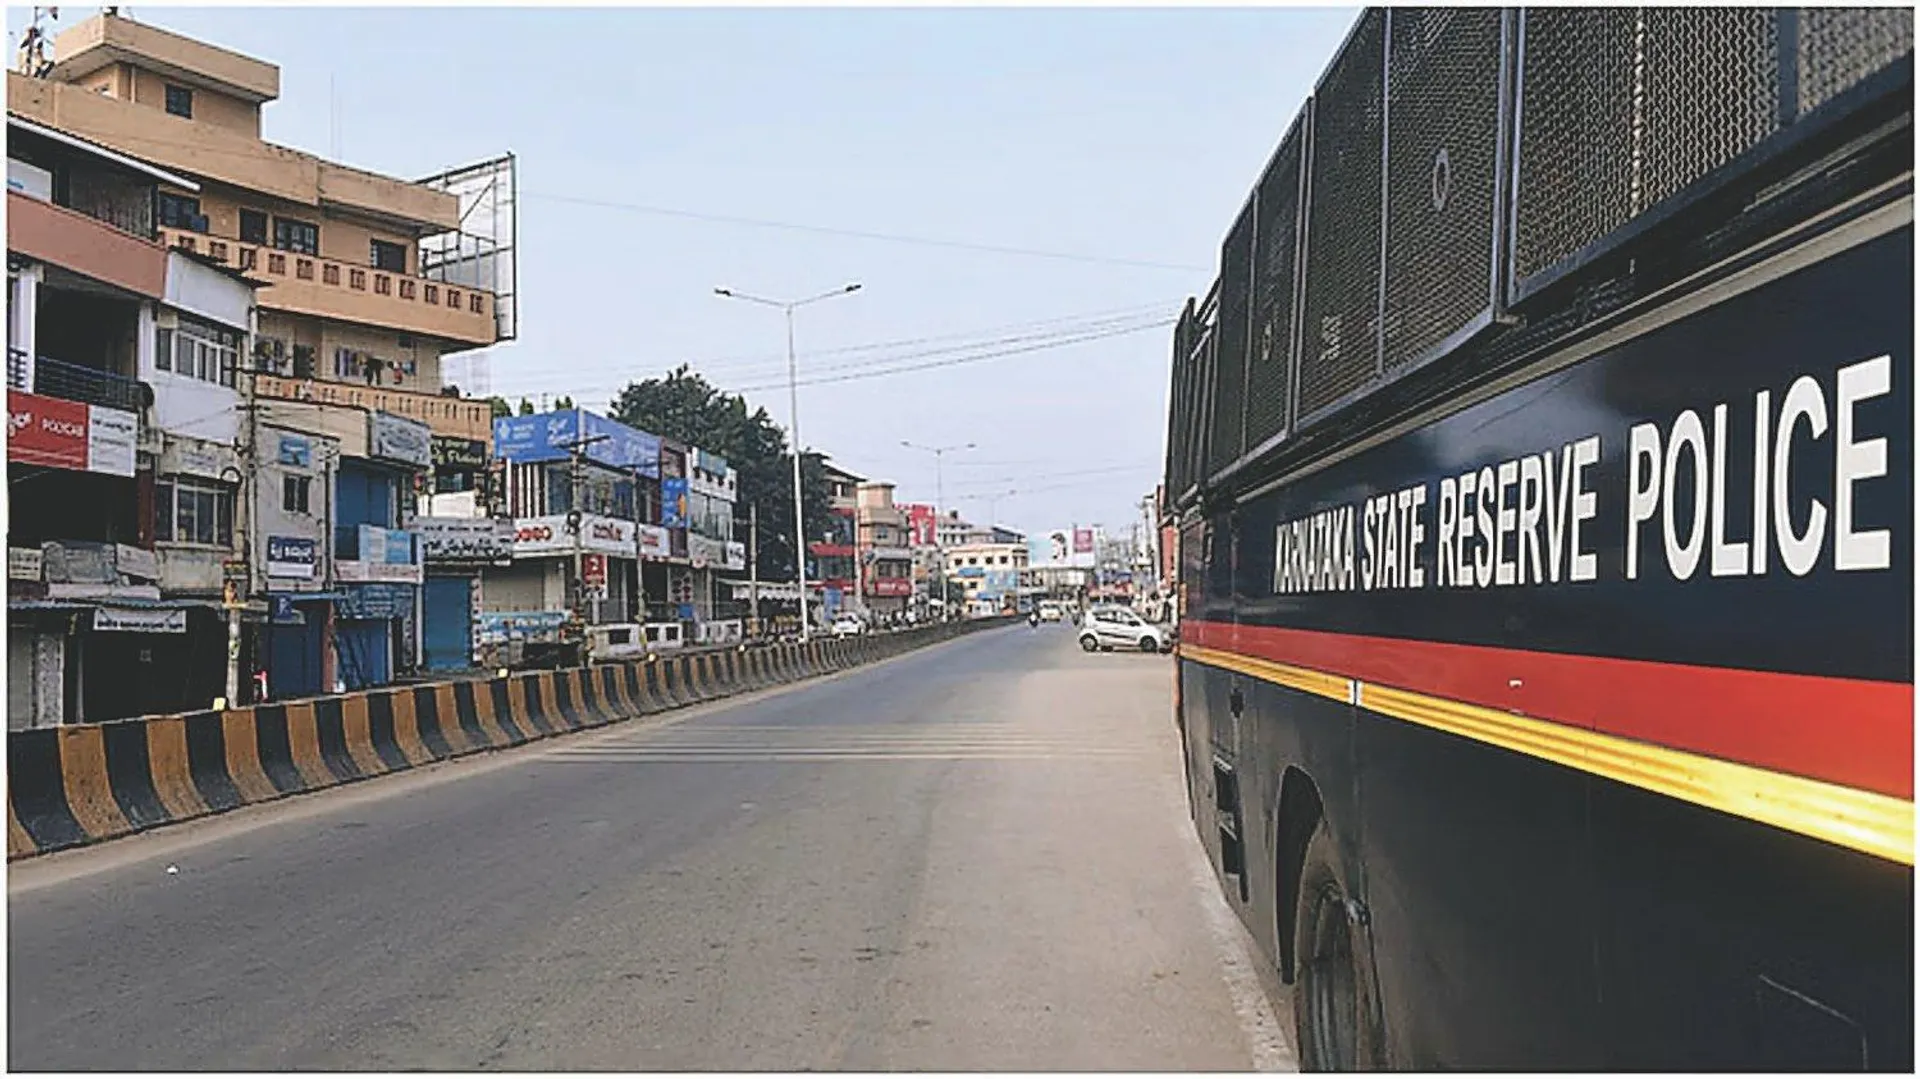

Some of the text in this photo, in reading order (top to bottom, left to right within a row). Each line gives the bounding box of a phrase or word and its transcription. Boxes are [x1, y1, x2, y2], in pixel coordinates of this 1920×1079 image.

[1273, 355, 1892, 593] KARNATAKA STATE RESERVE POLICE
